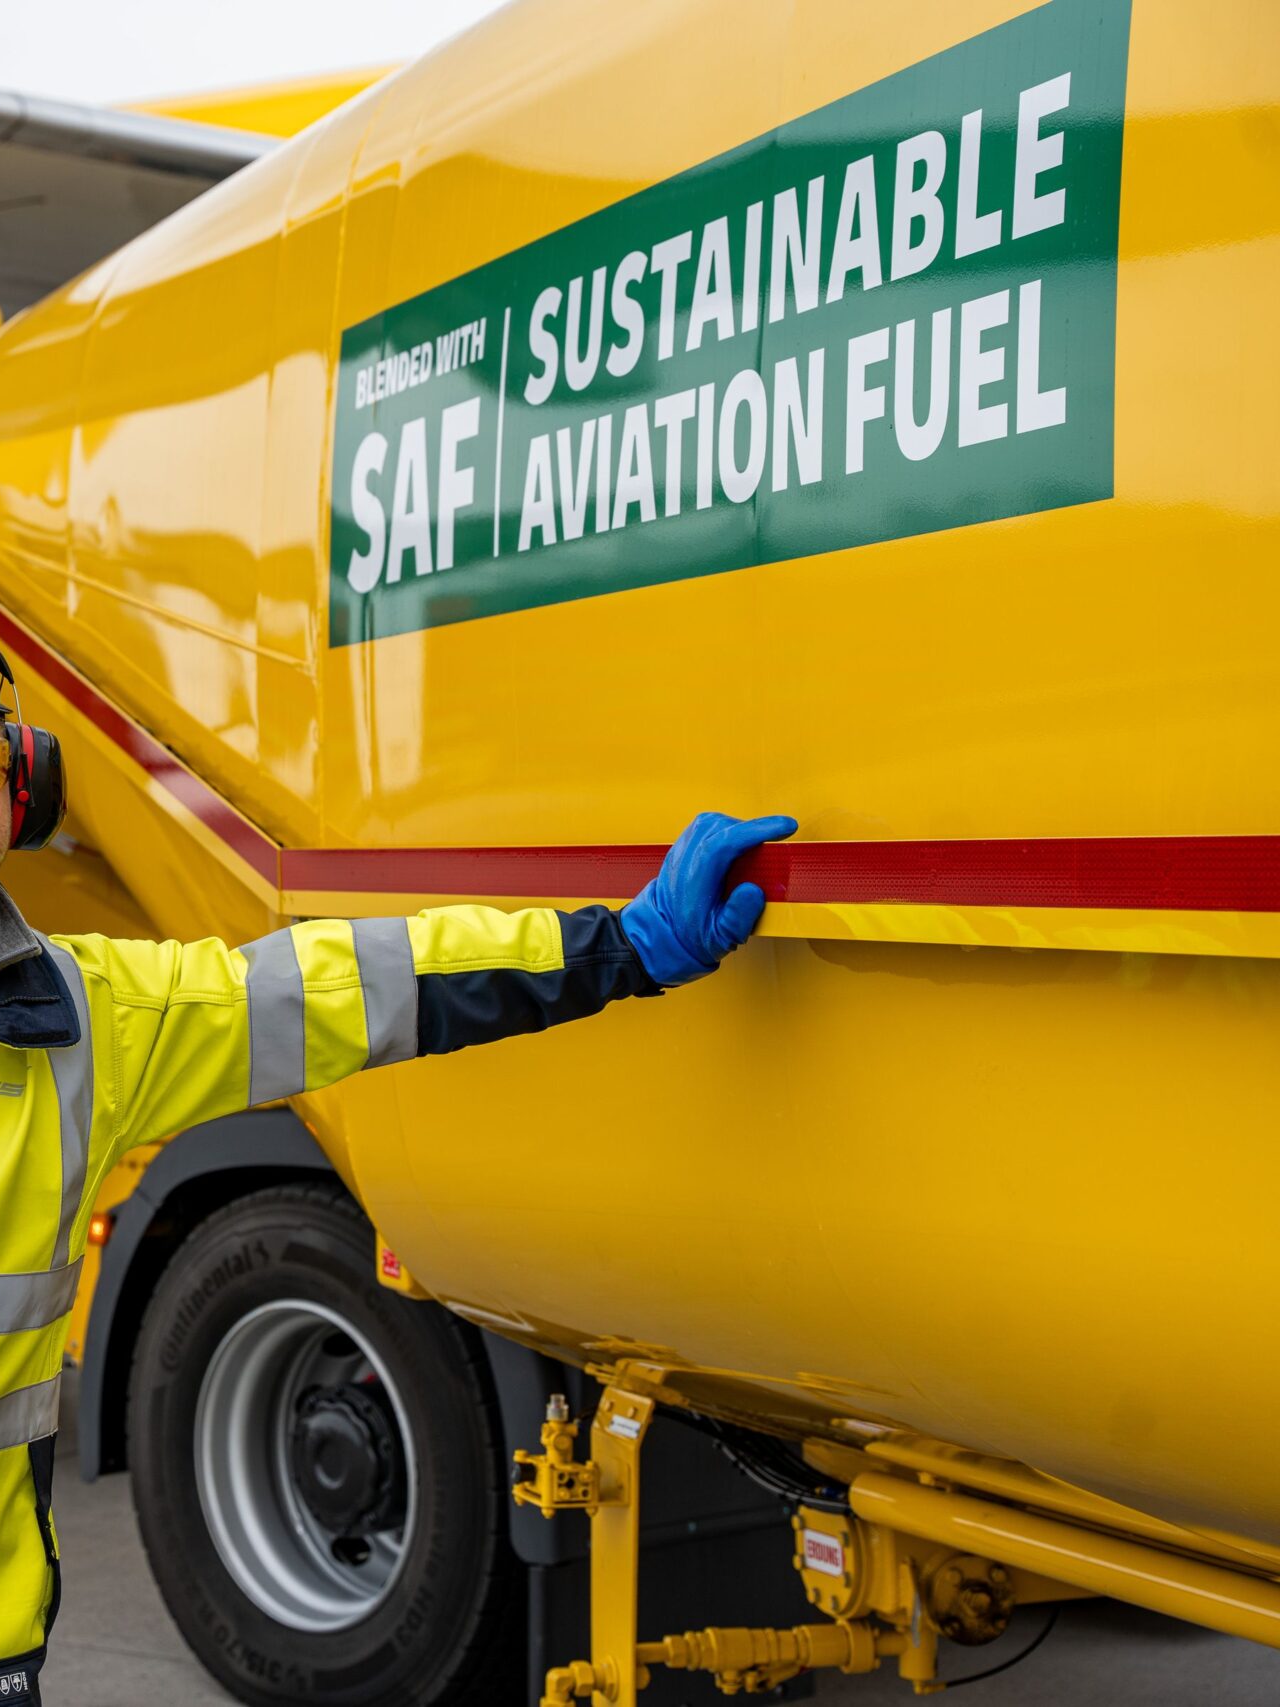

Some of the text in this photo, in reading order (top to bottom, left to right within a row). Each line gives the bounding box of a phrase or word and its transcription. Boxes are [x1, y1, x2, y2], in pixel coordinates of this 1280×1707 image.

[524, 72, 1071, 405] SUSTAINABLE
[355, 317, 487, 410] BLENDED WITH
[518, 280, 1066, 552] AVIATION FUEL
[347, 397, 481, 594] SAF
[160, 1243, 254, 1372] Continental
